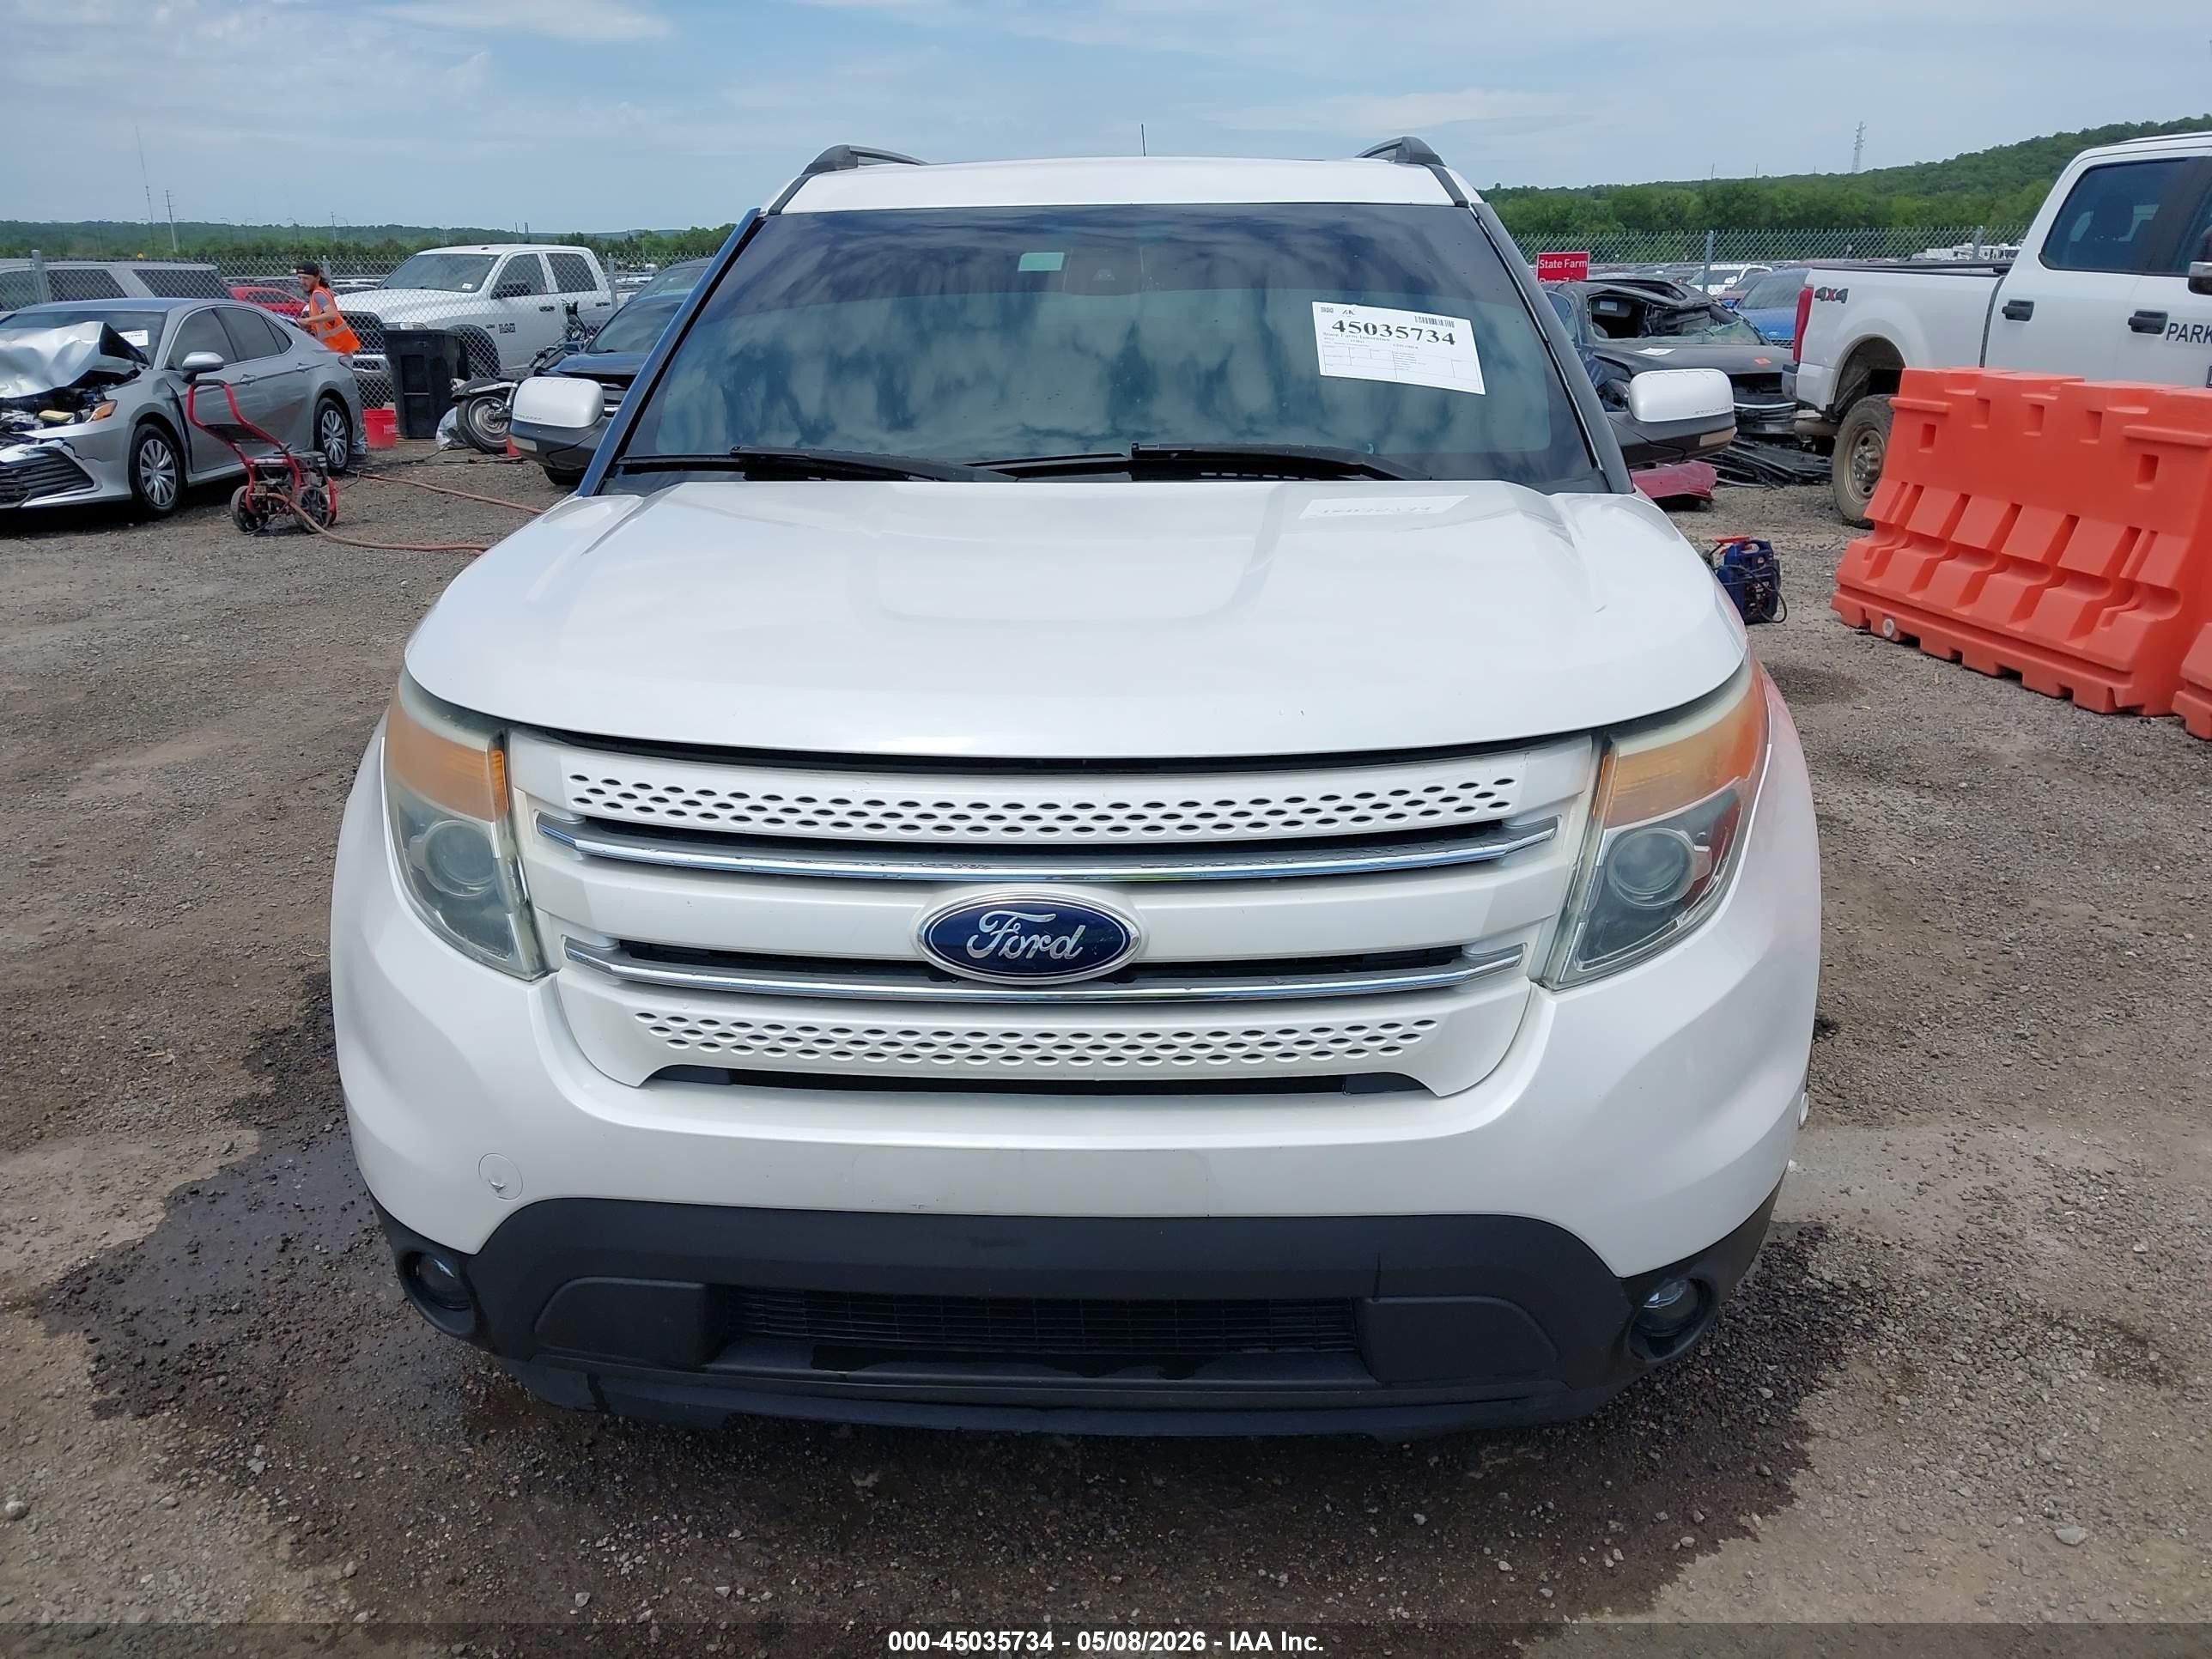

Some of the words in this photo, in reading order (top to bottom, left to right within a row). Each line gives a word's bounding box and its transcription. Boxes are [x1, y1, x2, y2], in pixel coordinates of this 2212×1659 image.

[1540, 259, 1563, 269] State
[1564, 258, 1588, 269] Farm
[1332, 319, 1456, 345] 45035734
[2166, 322, 2212, 343] PARK
[966, 910, 1086, 960] Ford
